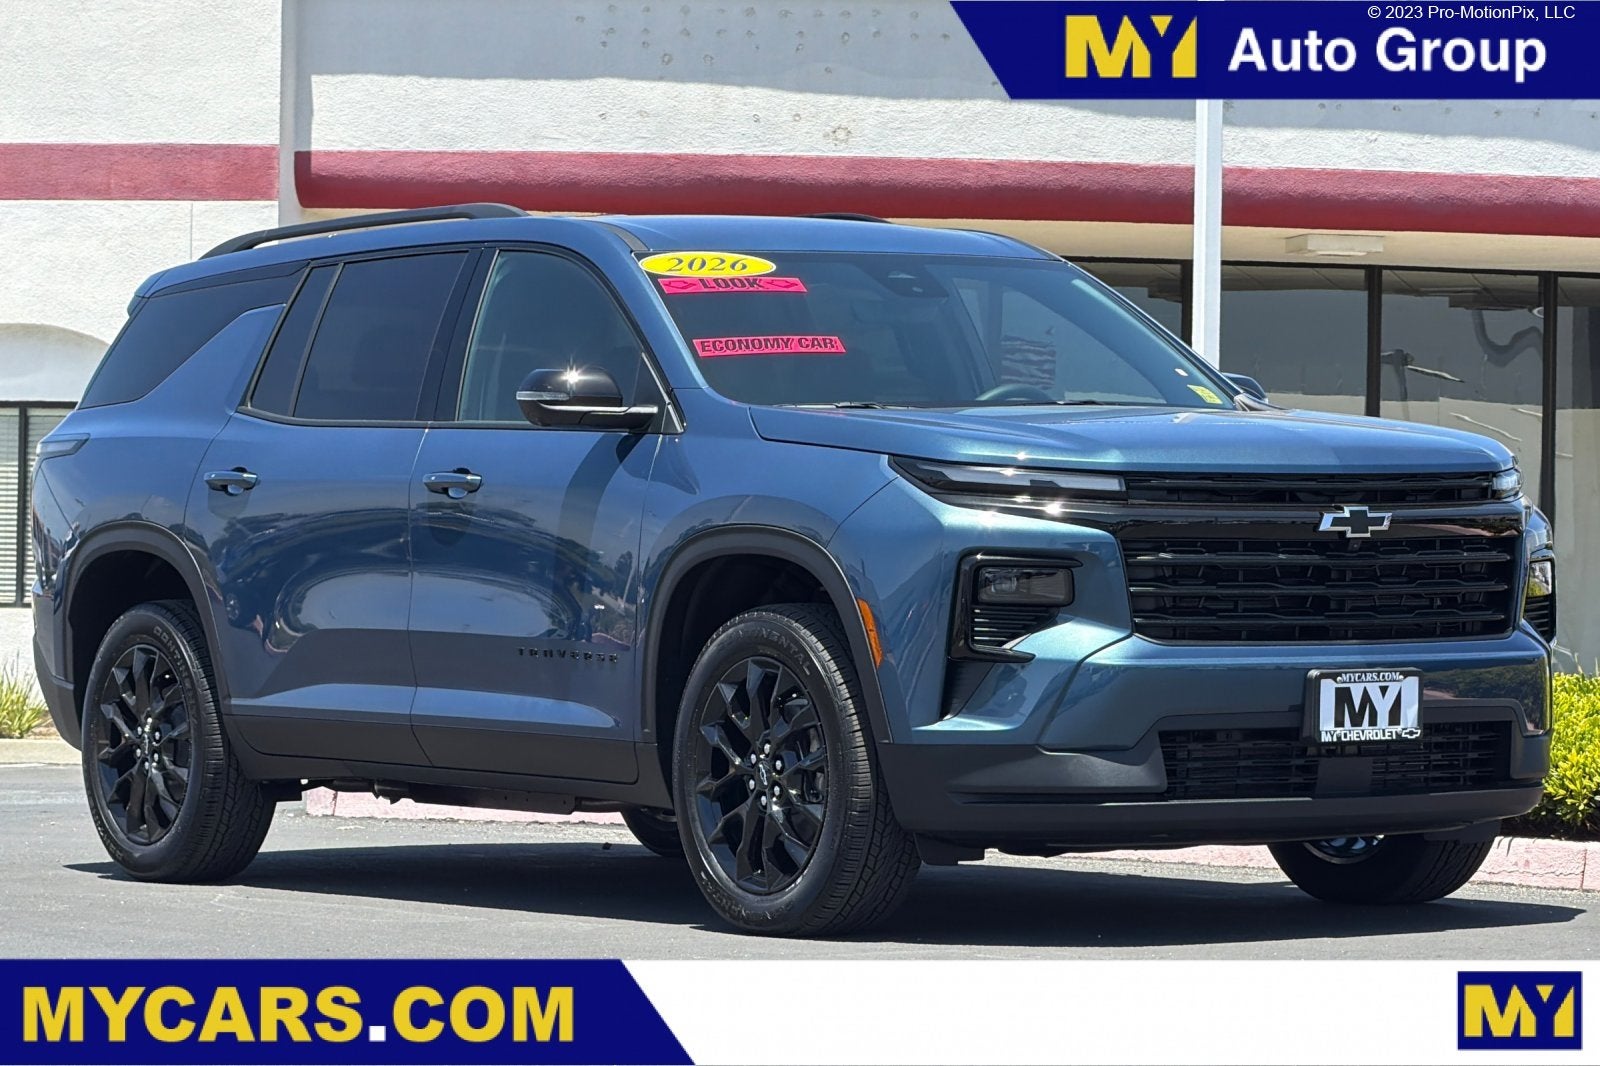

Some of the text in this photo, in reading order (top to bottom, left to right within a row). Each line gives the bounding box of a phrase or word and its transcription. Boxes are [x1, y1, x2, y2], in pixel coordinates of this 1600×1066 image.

[666, 256, 749, 272] 2026
[699, 277, 764, 290] LOOK
[700, 336, 838, 353] ECONOMY CAR
[1341, 671, 1401, 683] MYCARS.COM
[1334, 684, 1402, 728] MY
[1321, 729, 1397, 743] MY CHEVROLET
